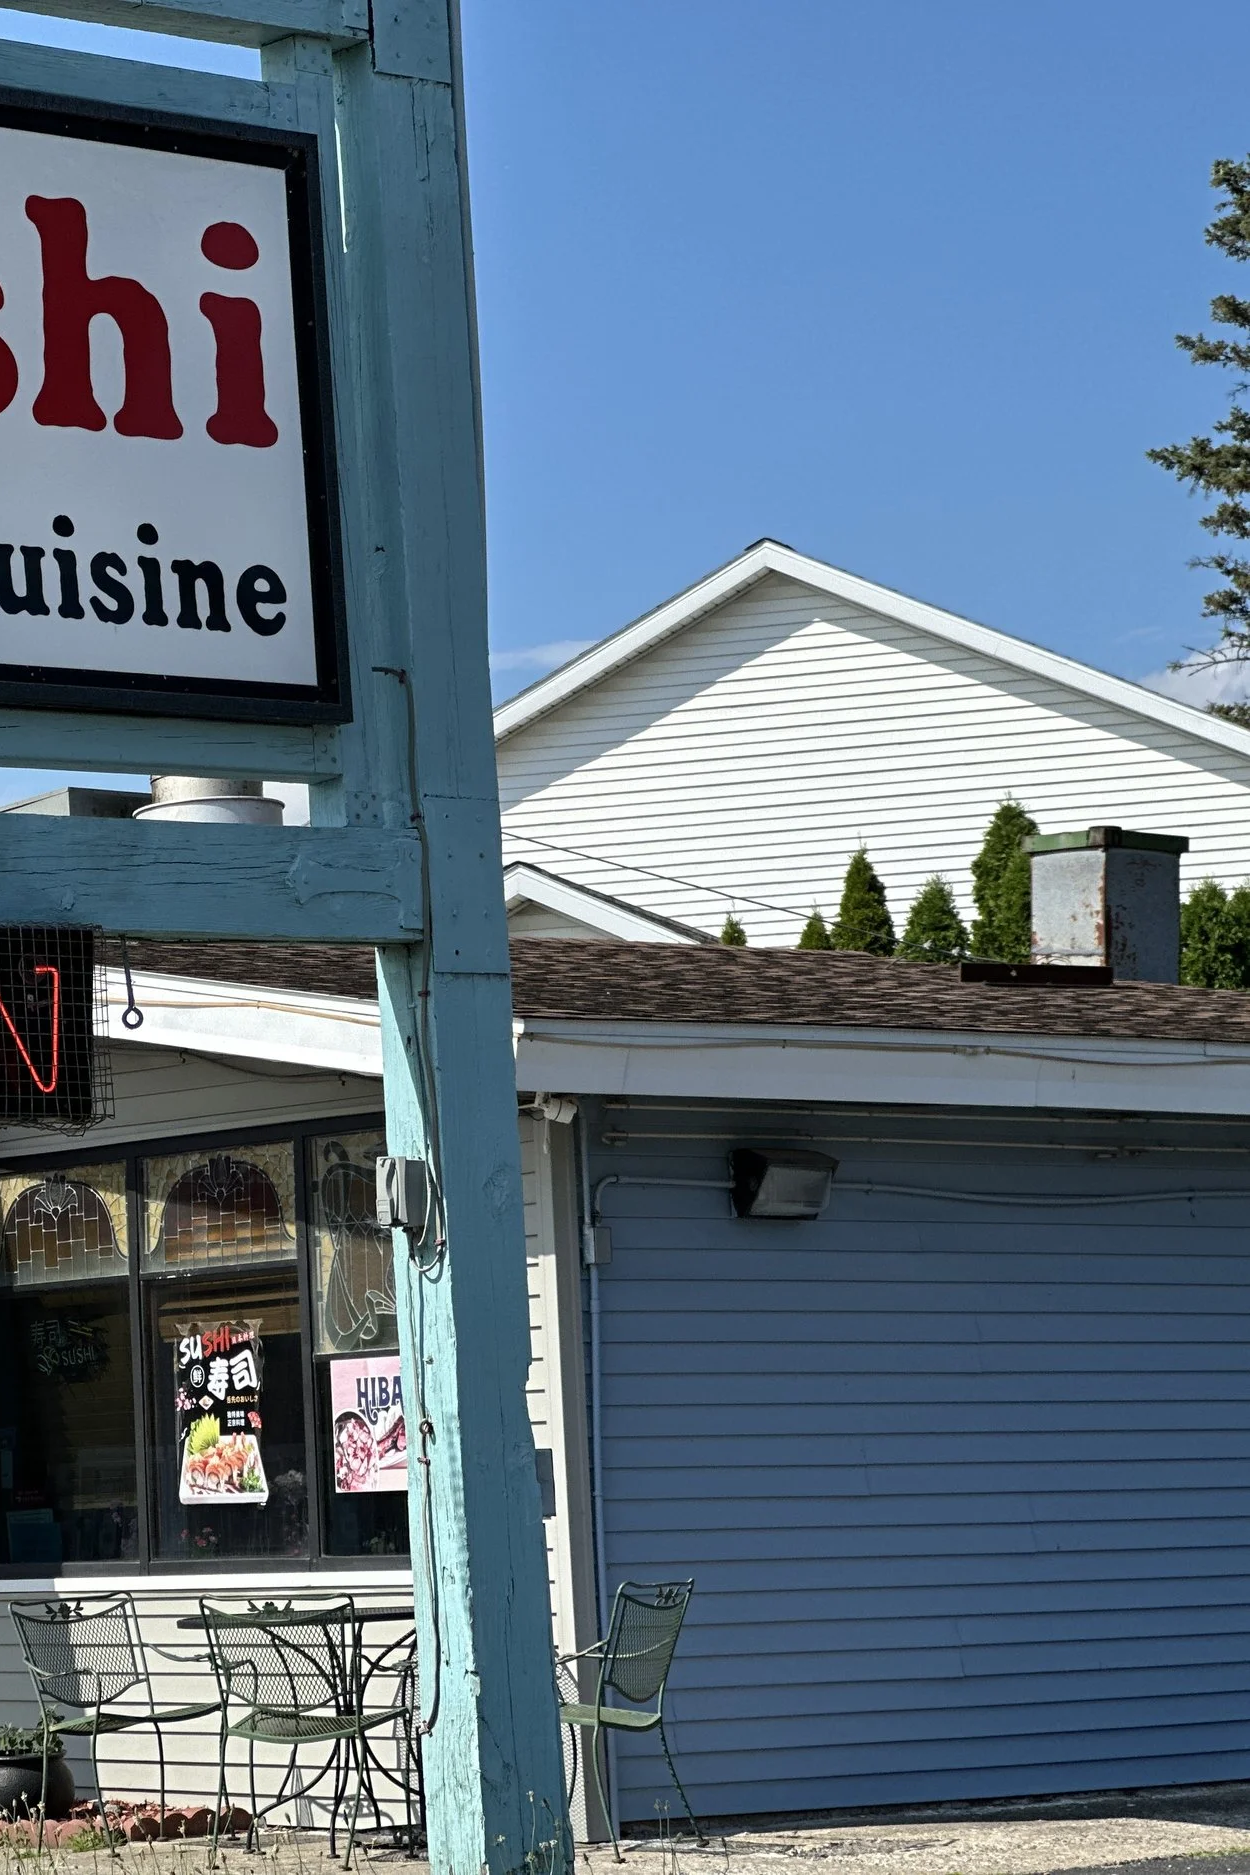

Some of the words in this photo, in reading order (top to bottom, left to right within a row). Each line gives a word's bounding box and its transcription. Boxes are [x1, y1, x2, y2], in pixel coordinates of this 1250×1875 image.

[30, 1320, 62, 1348] 寿司
[179, 1325, 230, 1365] SUSHI
[61, 1346, 95, 1366] SUSHI
[207, 1348, 257, 1400] 寿司
